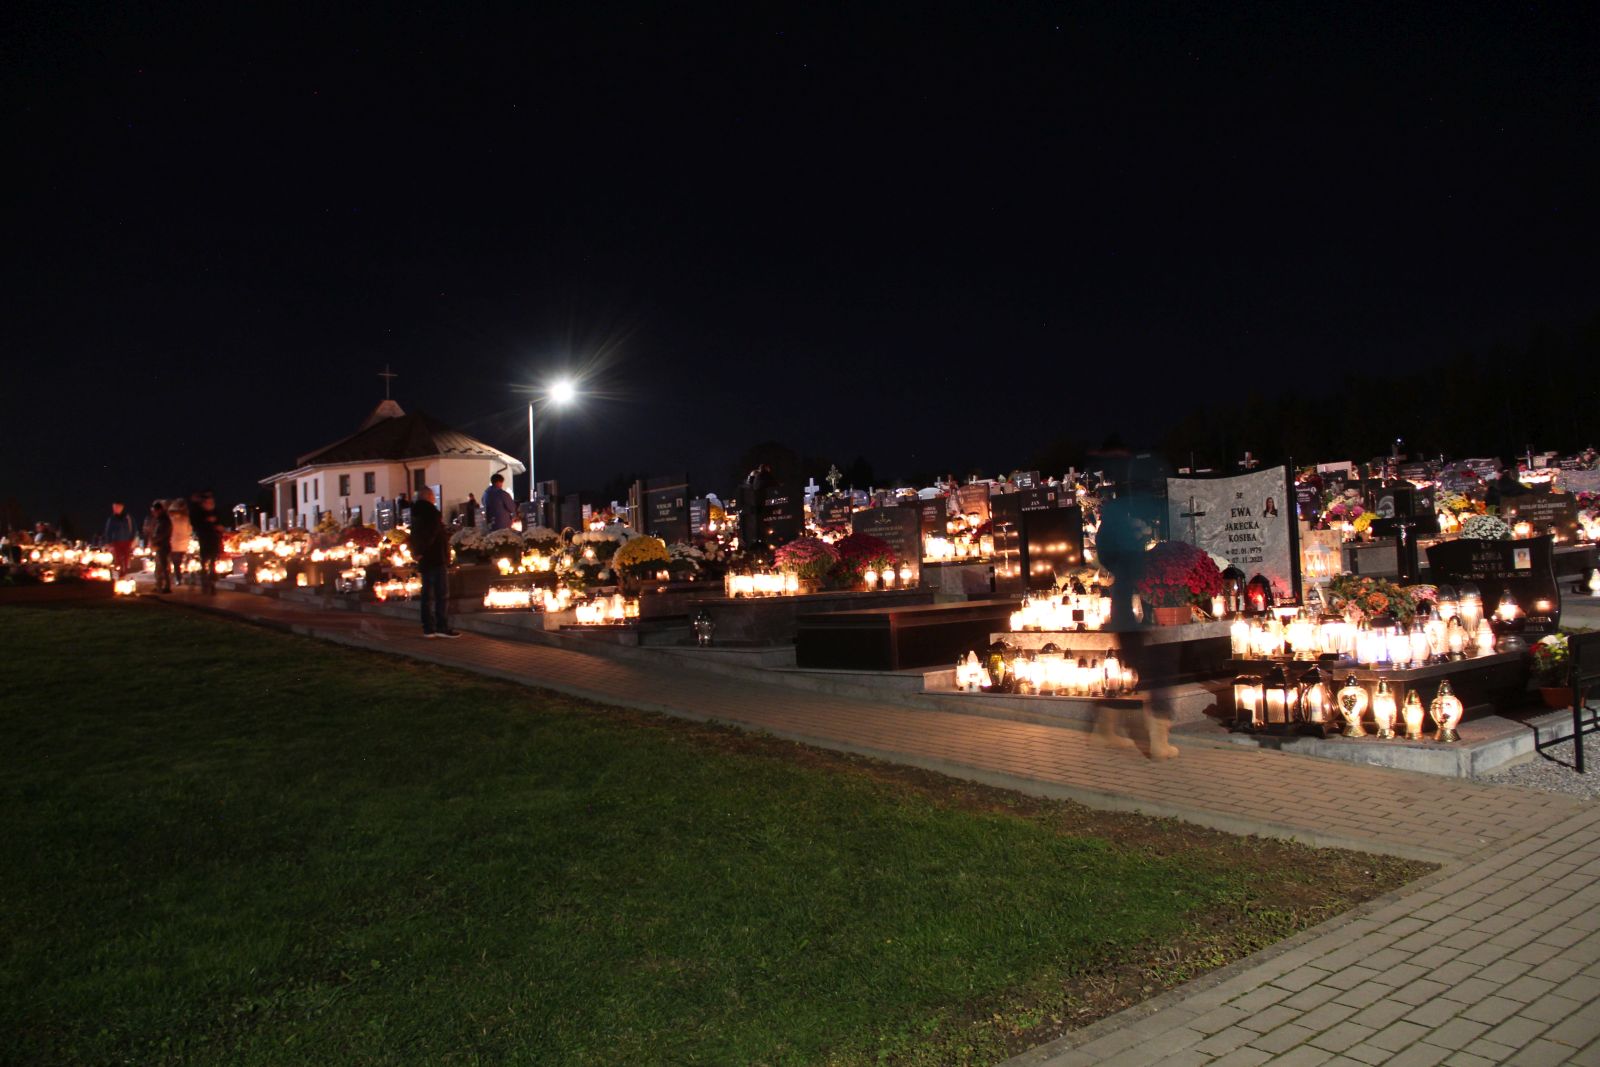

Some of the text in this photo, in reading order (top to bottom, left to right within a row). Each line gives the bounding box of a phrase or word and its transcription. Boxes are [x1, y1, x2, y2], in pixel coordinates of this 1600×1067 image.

[1231, 507, 1251, 517] EWA
[1224, 522, 1259, 531] JARECKA
[1228, 534, 1257, 542] KOSIBA
